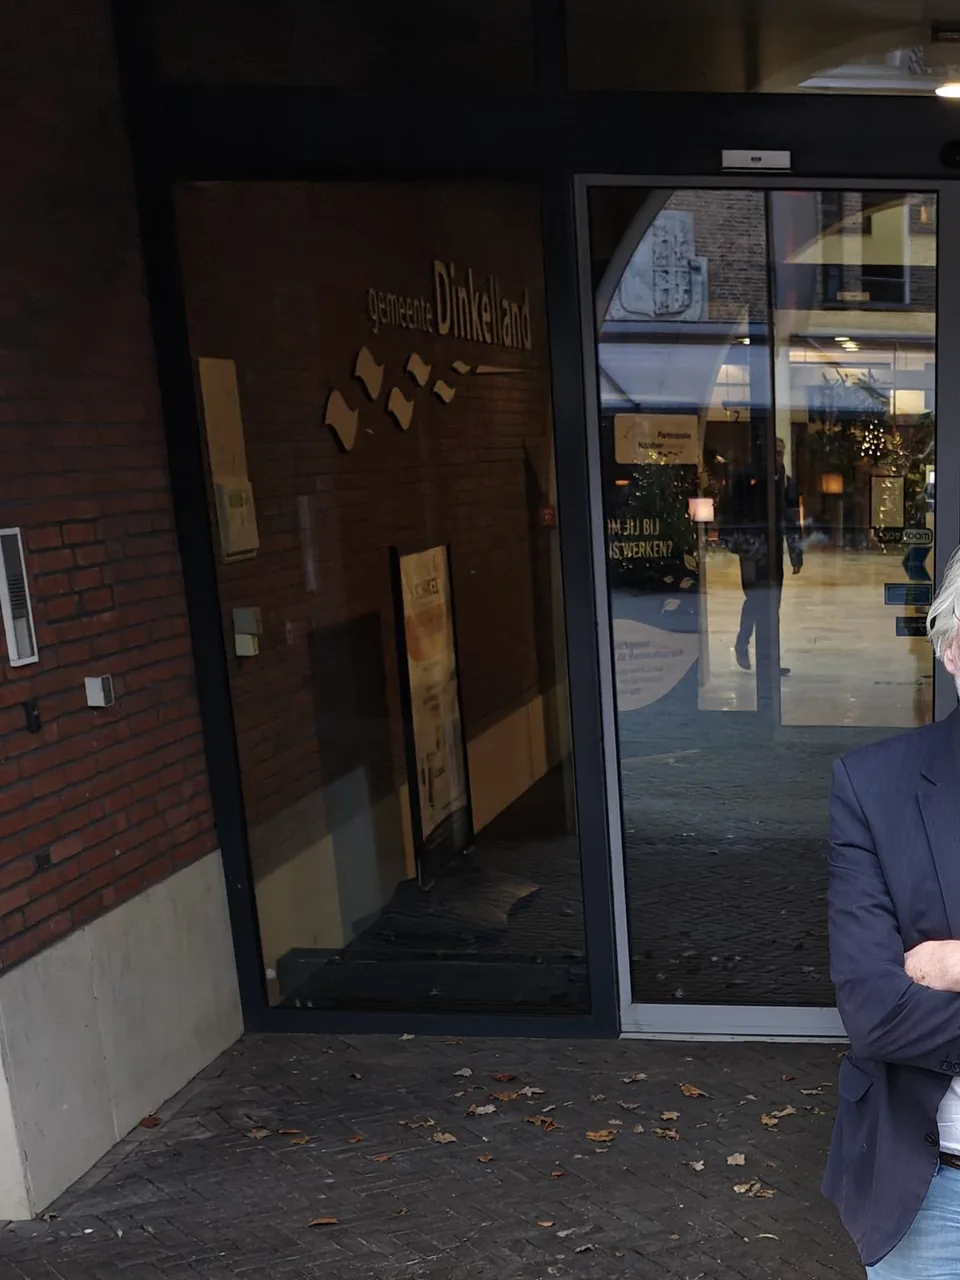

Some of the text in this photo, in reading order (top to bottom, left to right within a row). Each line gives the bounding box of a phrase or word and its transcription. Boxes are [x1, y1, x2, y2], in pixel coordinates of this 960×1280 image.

[368, 259, 532, 350] gemeente Dinkelland
[643, 518, 660, 535] BIJ
[623, 540, 673, 558] WERKEN?
